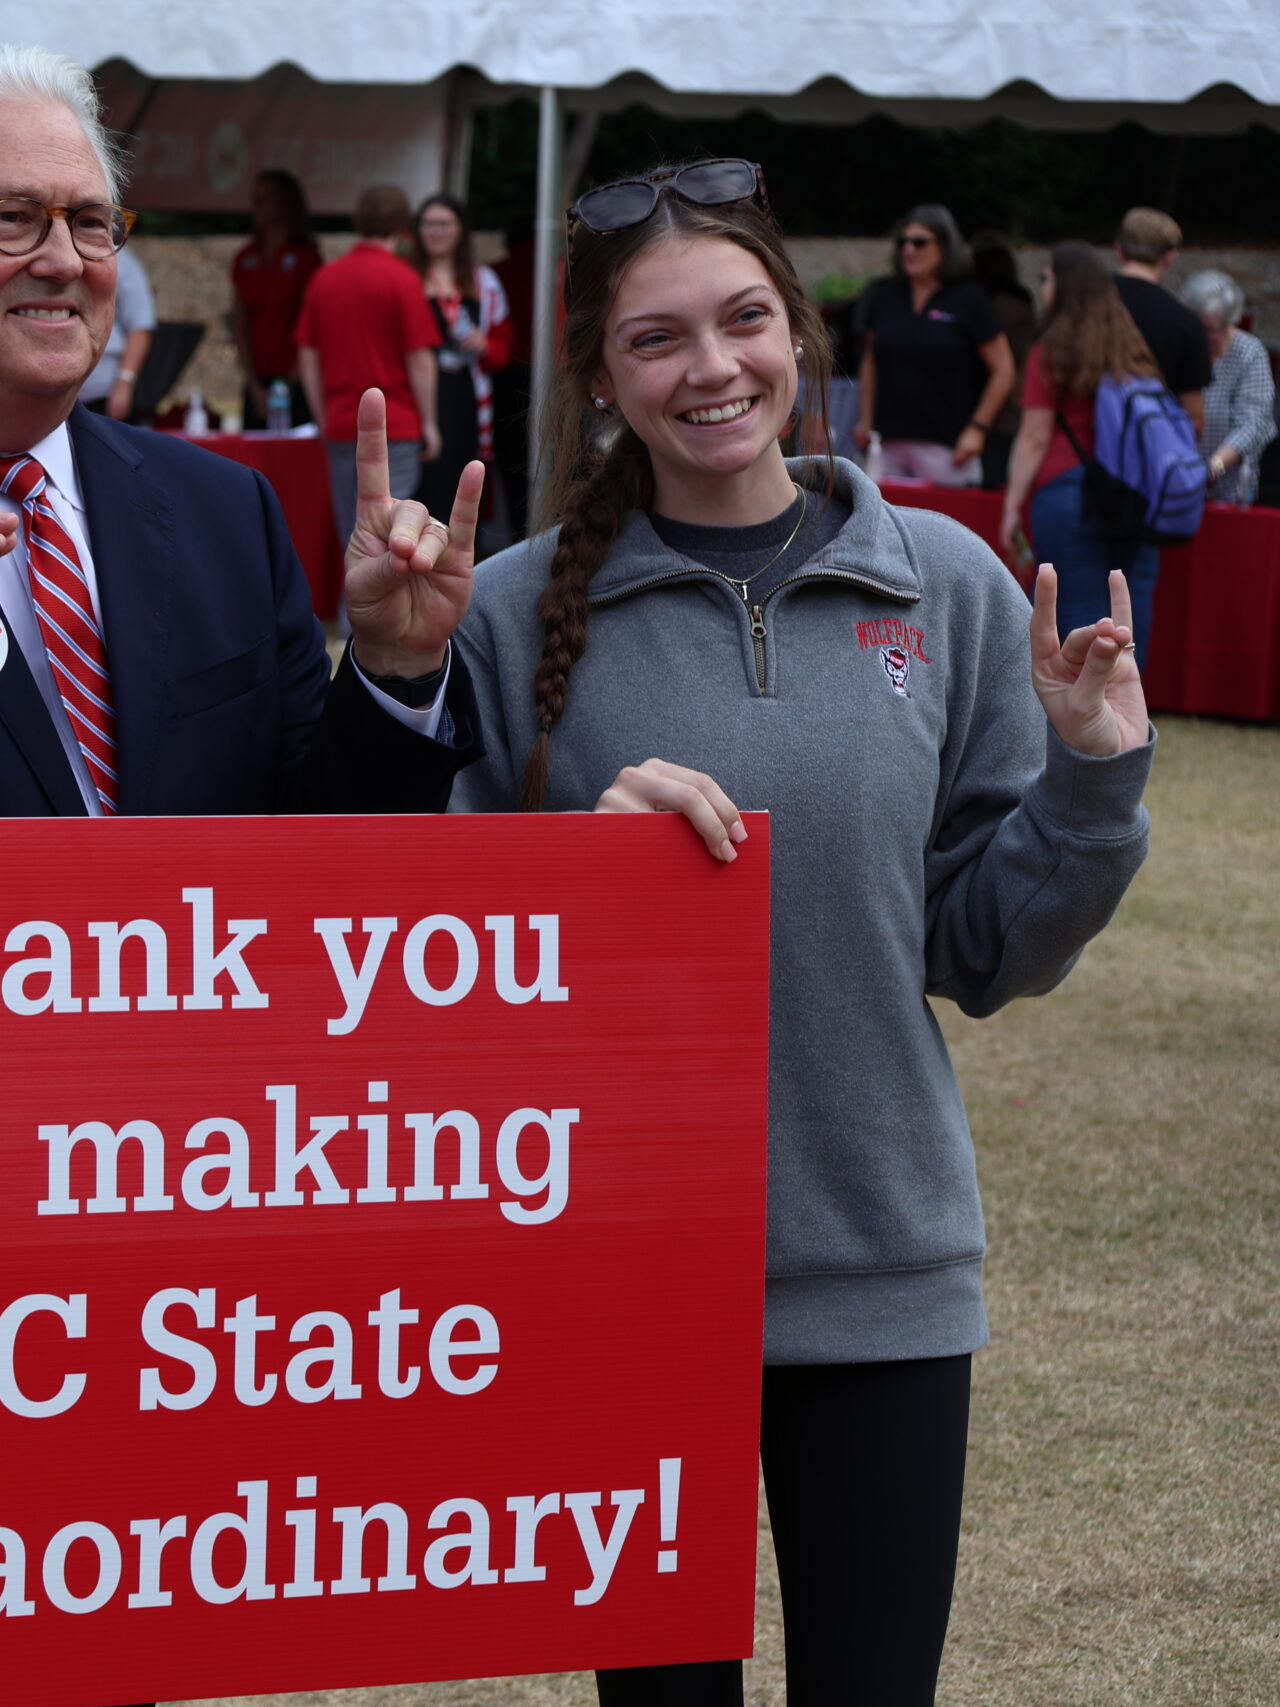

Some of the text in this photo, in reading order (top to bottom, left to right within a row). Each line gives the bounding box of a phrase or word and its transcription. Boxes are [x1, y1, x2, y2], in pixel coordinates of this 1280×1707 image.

[855, 617, 932, 665] WOLFPACK
[313, 913, 568, 1035] you
[37, 1080, 580, 1225] making
[139, 1287, 501, 1411] State
